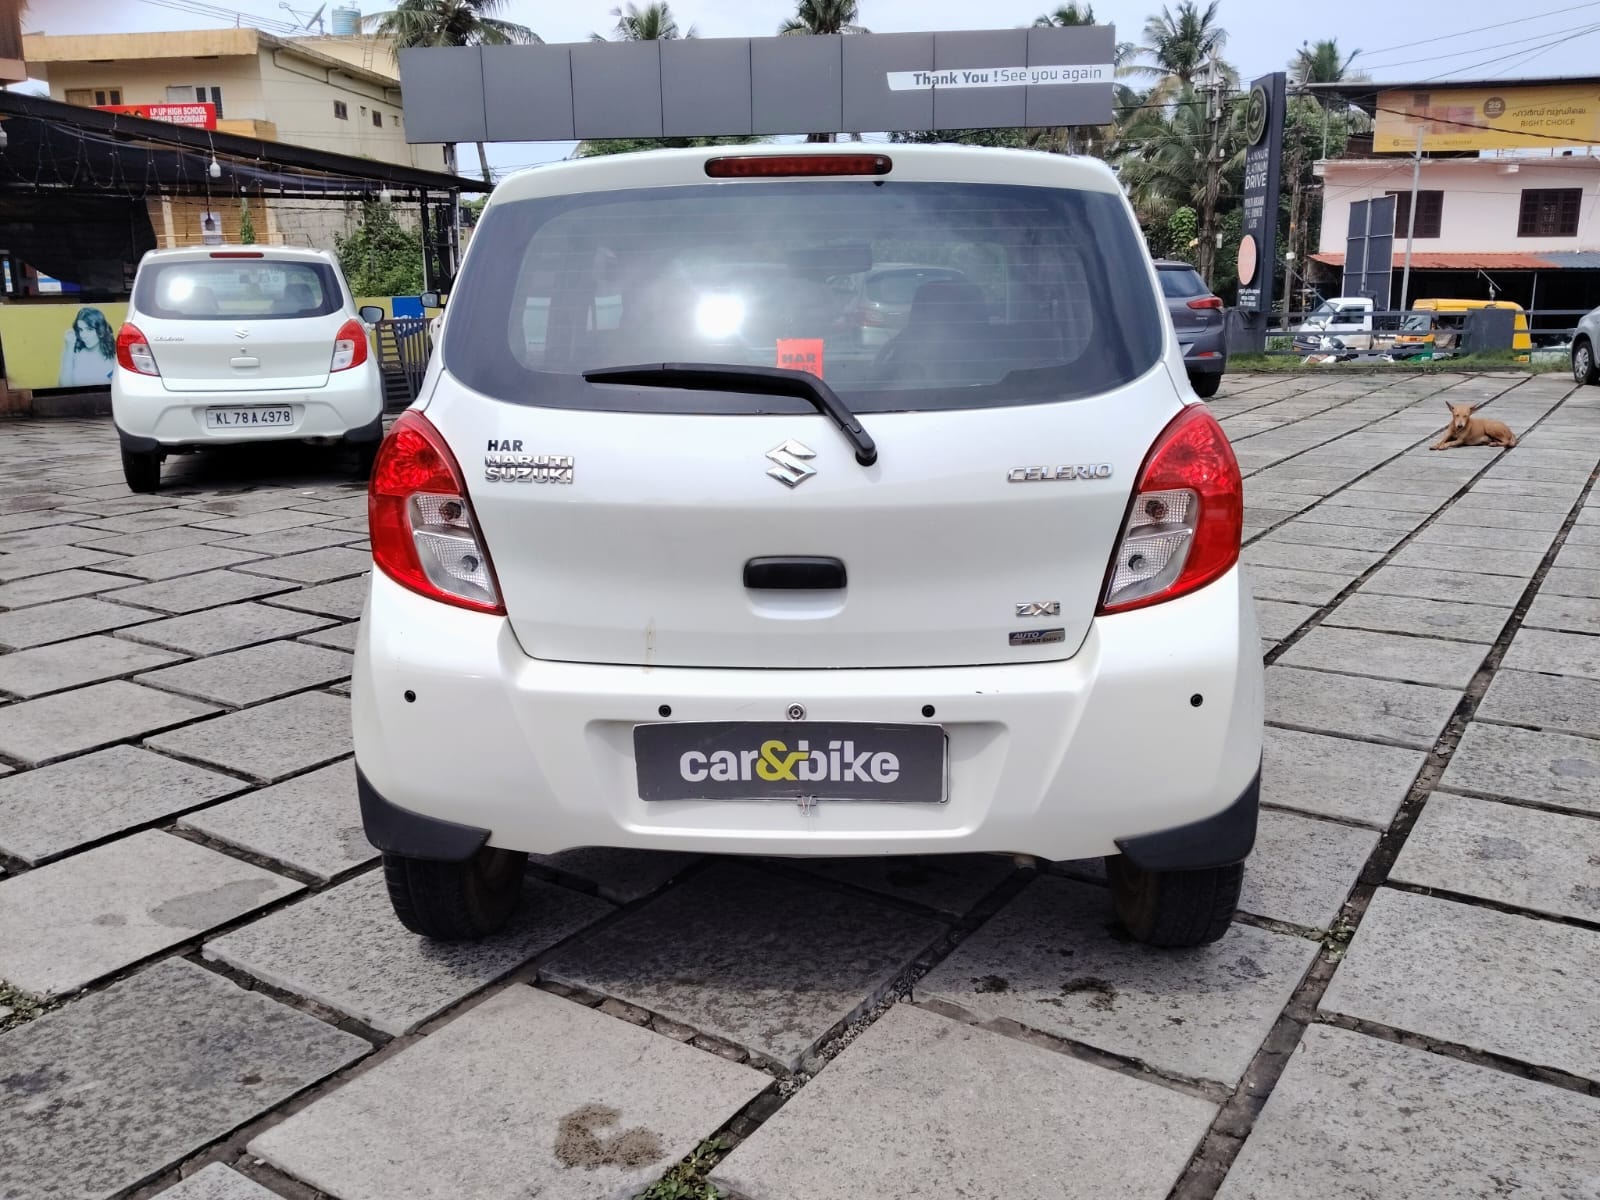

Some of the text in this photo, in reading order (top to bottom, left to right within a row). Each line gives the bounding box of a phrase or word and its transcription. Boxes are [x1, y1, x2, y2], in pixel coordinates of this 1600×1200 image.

[913, 69, 958, 85] Thank
[962, 71, 989, 83] You
[1001, 69, 1026, 82] See
[1031, 68, 1058, 84] you
[1063, 66, 1102, 83] again
[168, 107, 182, 115] HIGH
[183, 106, 207, 115] SCHOOL
[1520, 118, 1576, 127] RIGHT CHOICE
[1245, 172, 1267, 190] DRIVE
[782, 353, 816, 364] HAR
[216, 411, 290, 424] KL 78 A 4978
[487, 439, 523, 452] HAR
[485, 455, 574, 469] MARUTI
[485, 467, 573, 484] SUZUKI
[1007, 463, 1112, 482] CELERIO
[1013, 631, 1040, 639] AUTO
[680, 740, 900, 783] car&bike
